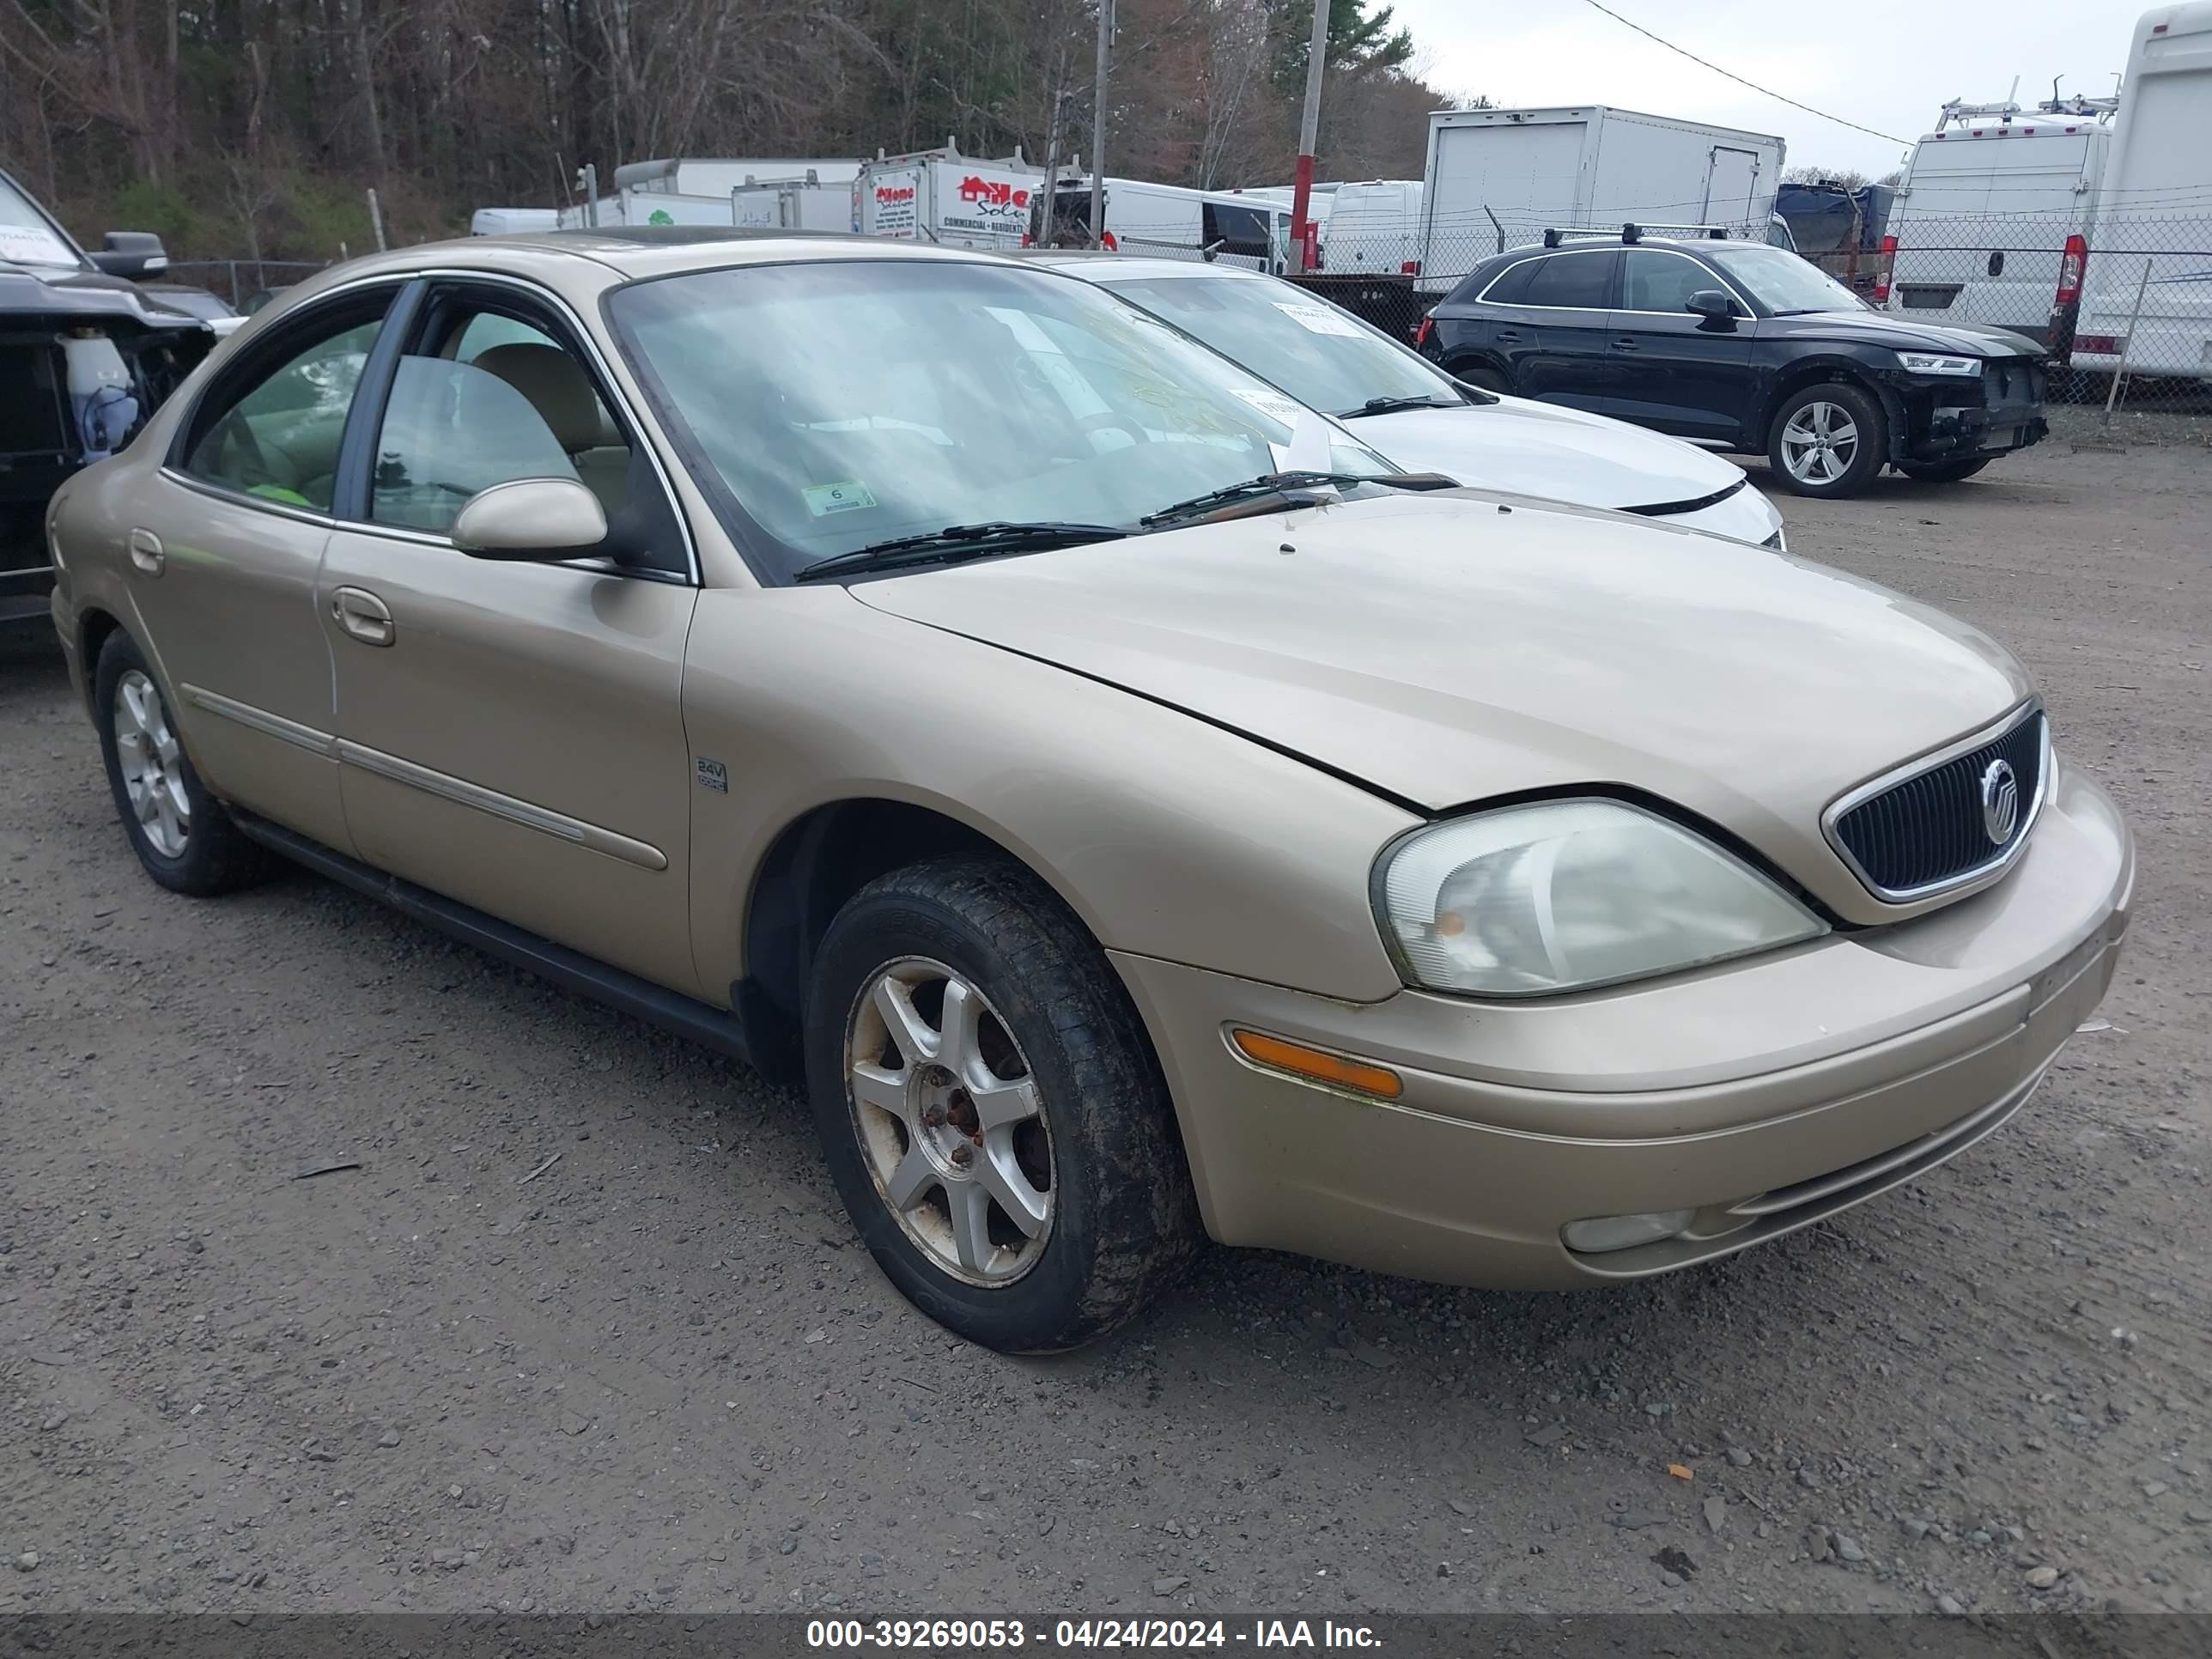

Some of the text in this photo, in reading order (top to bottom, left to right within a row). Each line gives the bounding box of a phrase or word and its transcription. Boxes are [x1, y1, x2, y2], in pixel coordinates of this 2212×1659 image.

[944, 216, 987, 230] COMMERCIAL
[831, 489, 842, 499] 6
[698, 761, 722, 776] 24V
